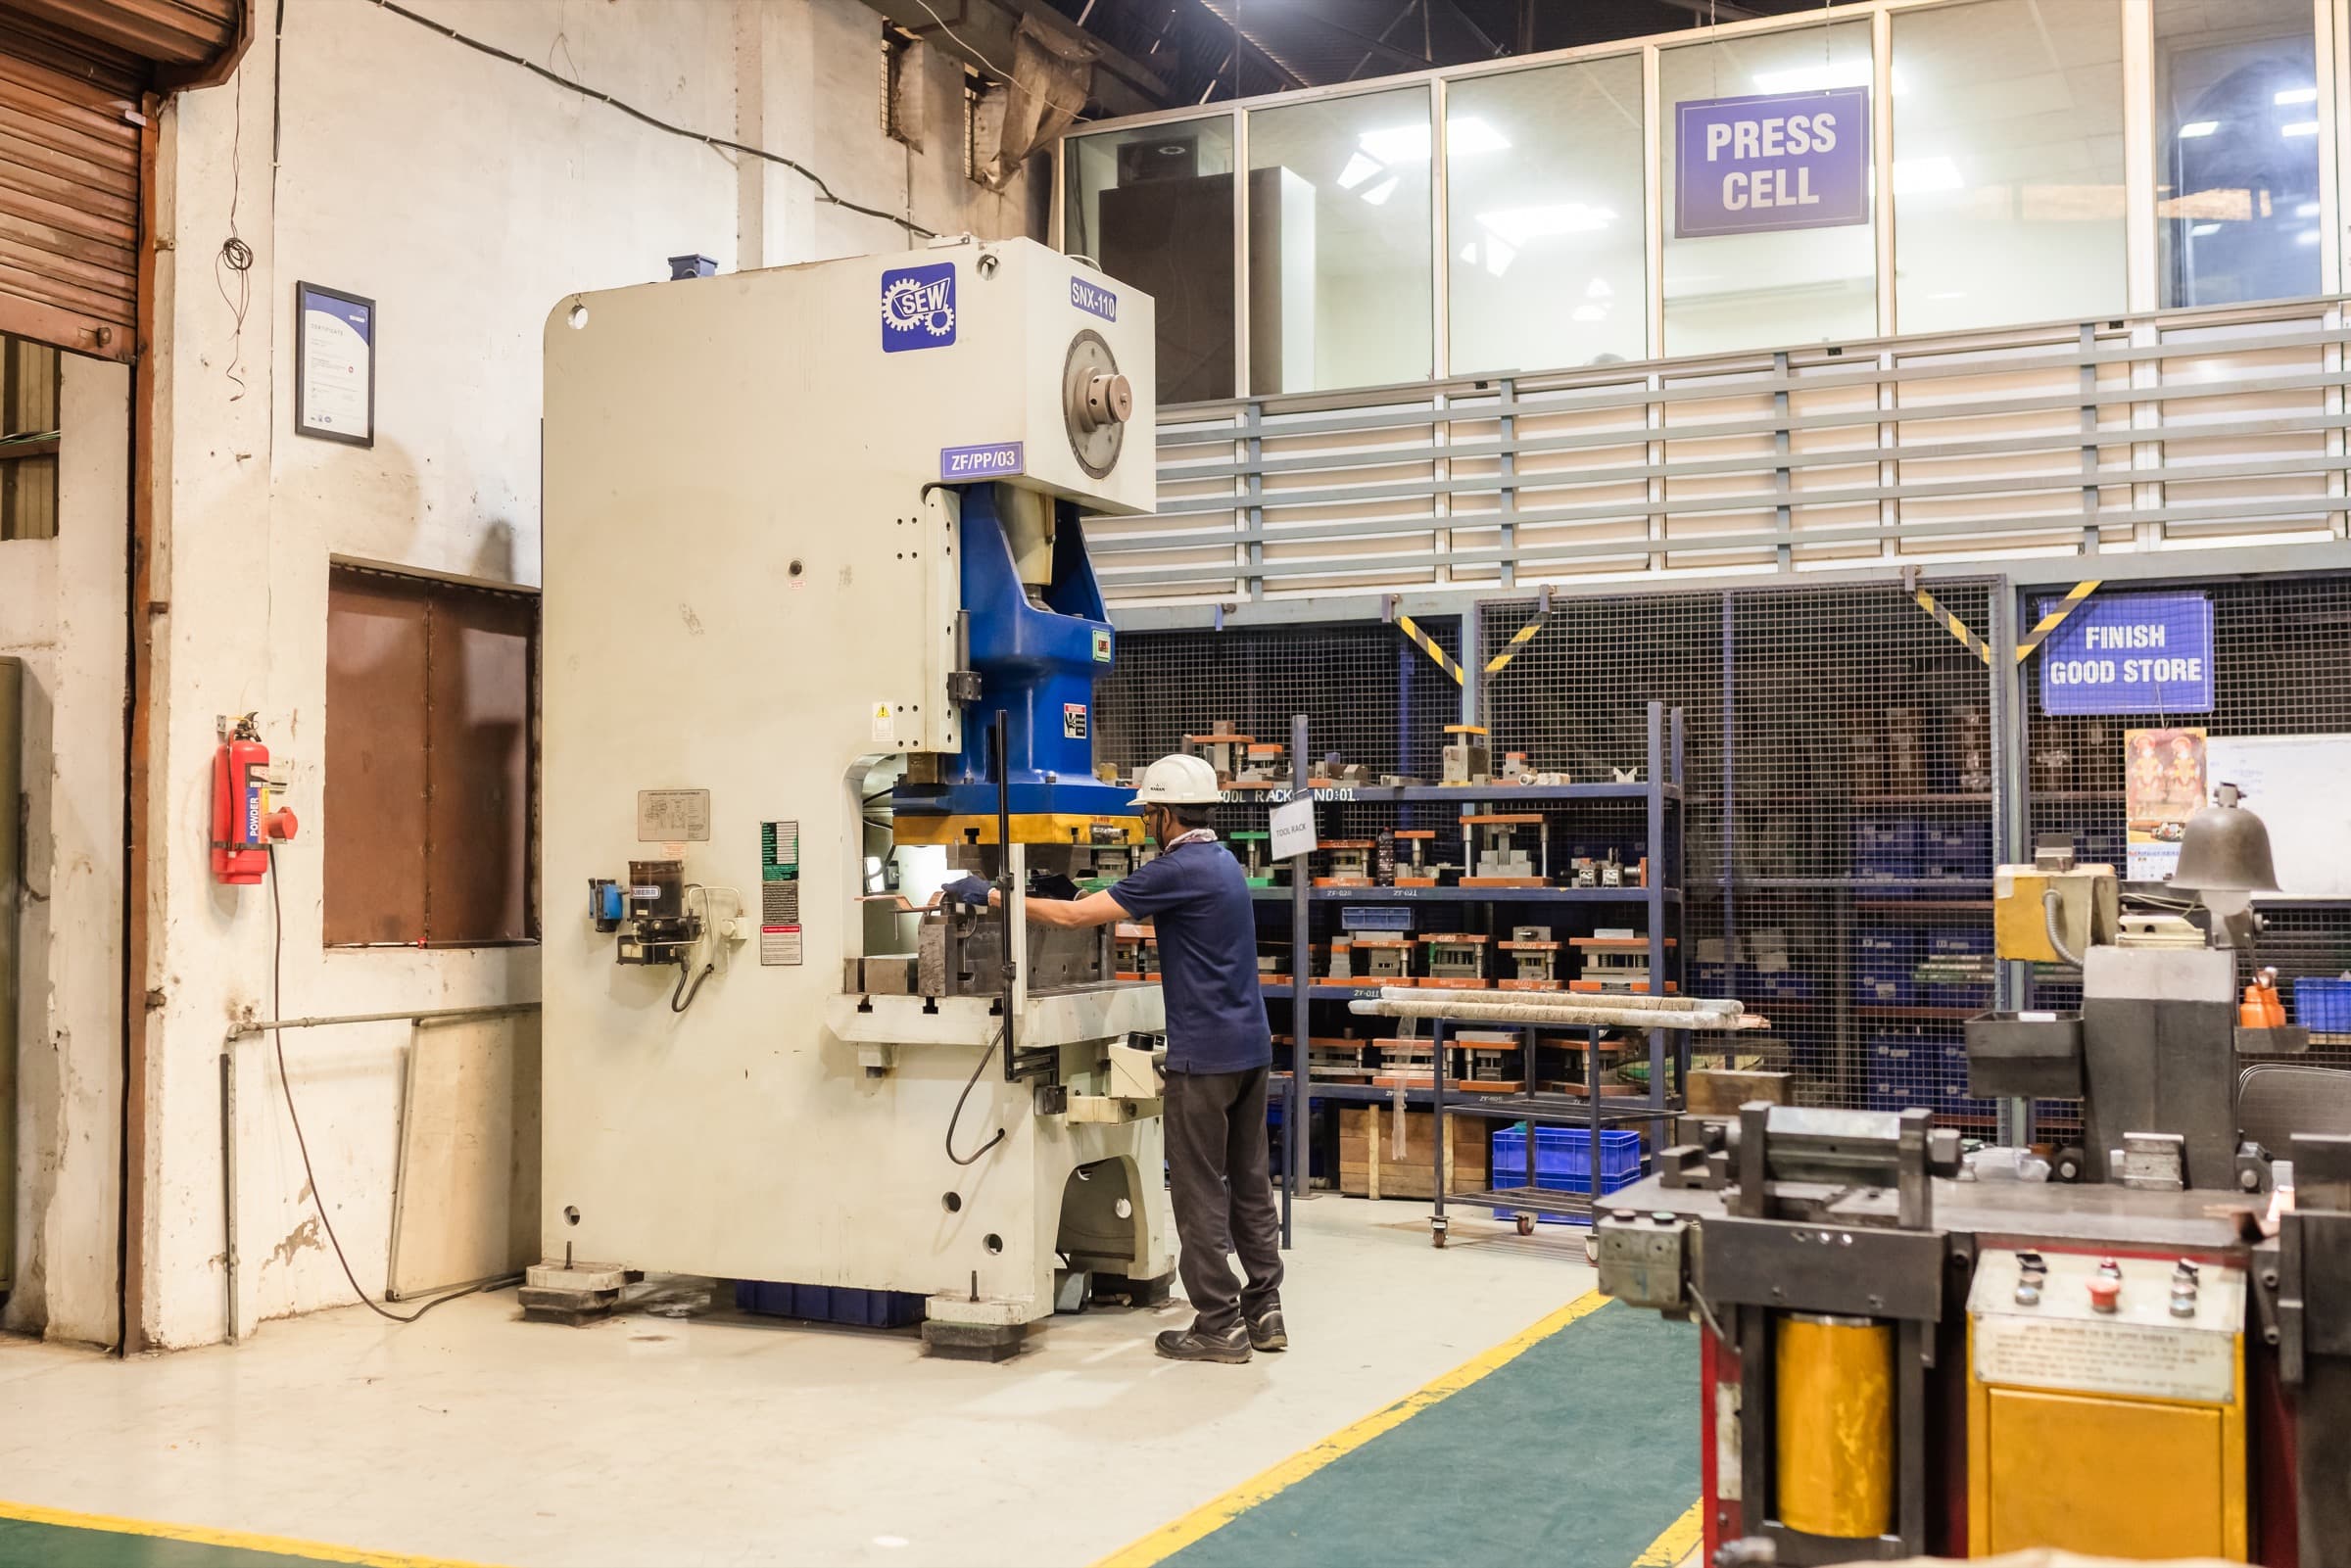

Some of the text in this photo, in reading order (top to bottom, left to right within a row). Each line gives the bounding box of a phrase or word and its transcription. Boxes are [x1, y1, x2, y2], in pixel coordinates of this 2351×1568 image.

[1706, 113, 1837, 162] PRESS
[1722, 166, 1820, 212] CELL
[900, 281, 947, 315] SEW
[1072, 283, 1116, 317] SNX-110
[951, 451, 1016, 471] ZF/PP/03
[2086, 624, 2166, 650] FINISH
[2050, 657, 2203, 685] GOOD STORE
[1255, 788, 1293, 803] RACK
[250, 797, 260, 837] POWDER
[1276, 824, 1307, 836] TOOL RACK
